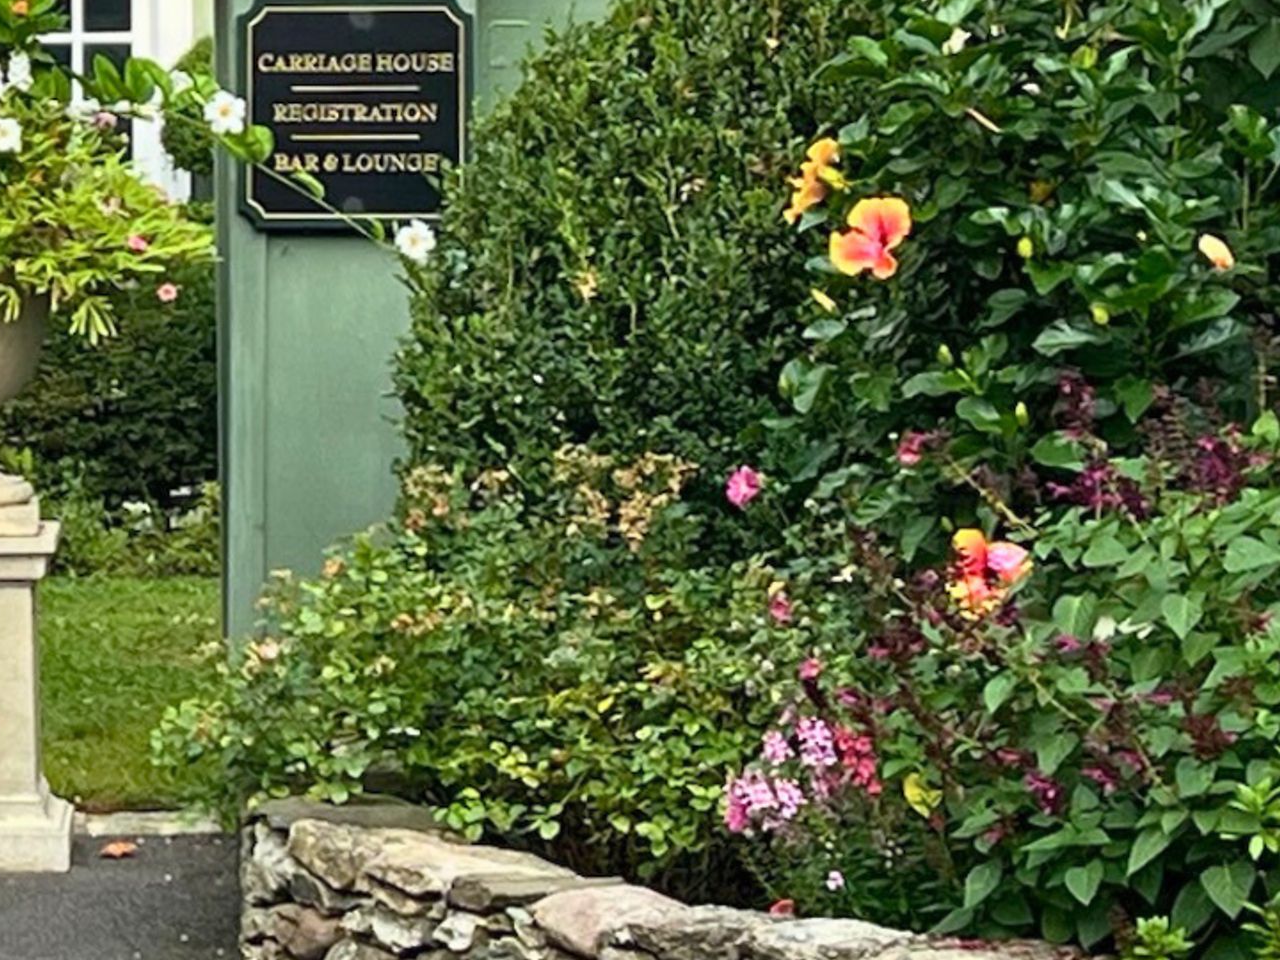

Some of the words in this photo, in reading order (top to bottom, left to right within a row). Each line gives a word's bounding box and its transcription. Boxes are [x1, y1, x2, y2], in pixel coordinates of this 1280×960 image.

[258, 53, 372, 72] CARRIAGE
[375, 53, 454, 72] HOUSE
[273, 103, 438, 122] REGISTRATION
[274, 153, 320, 172] BAR
[323, 154, 339, 172] &
[342, 153, 439, 172] LOUNGE
